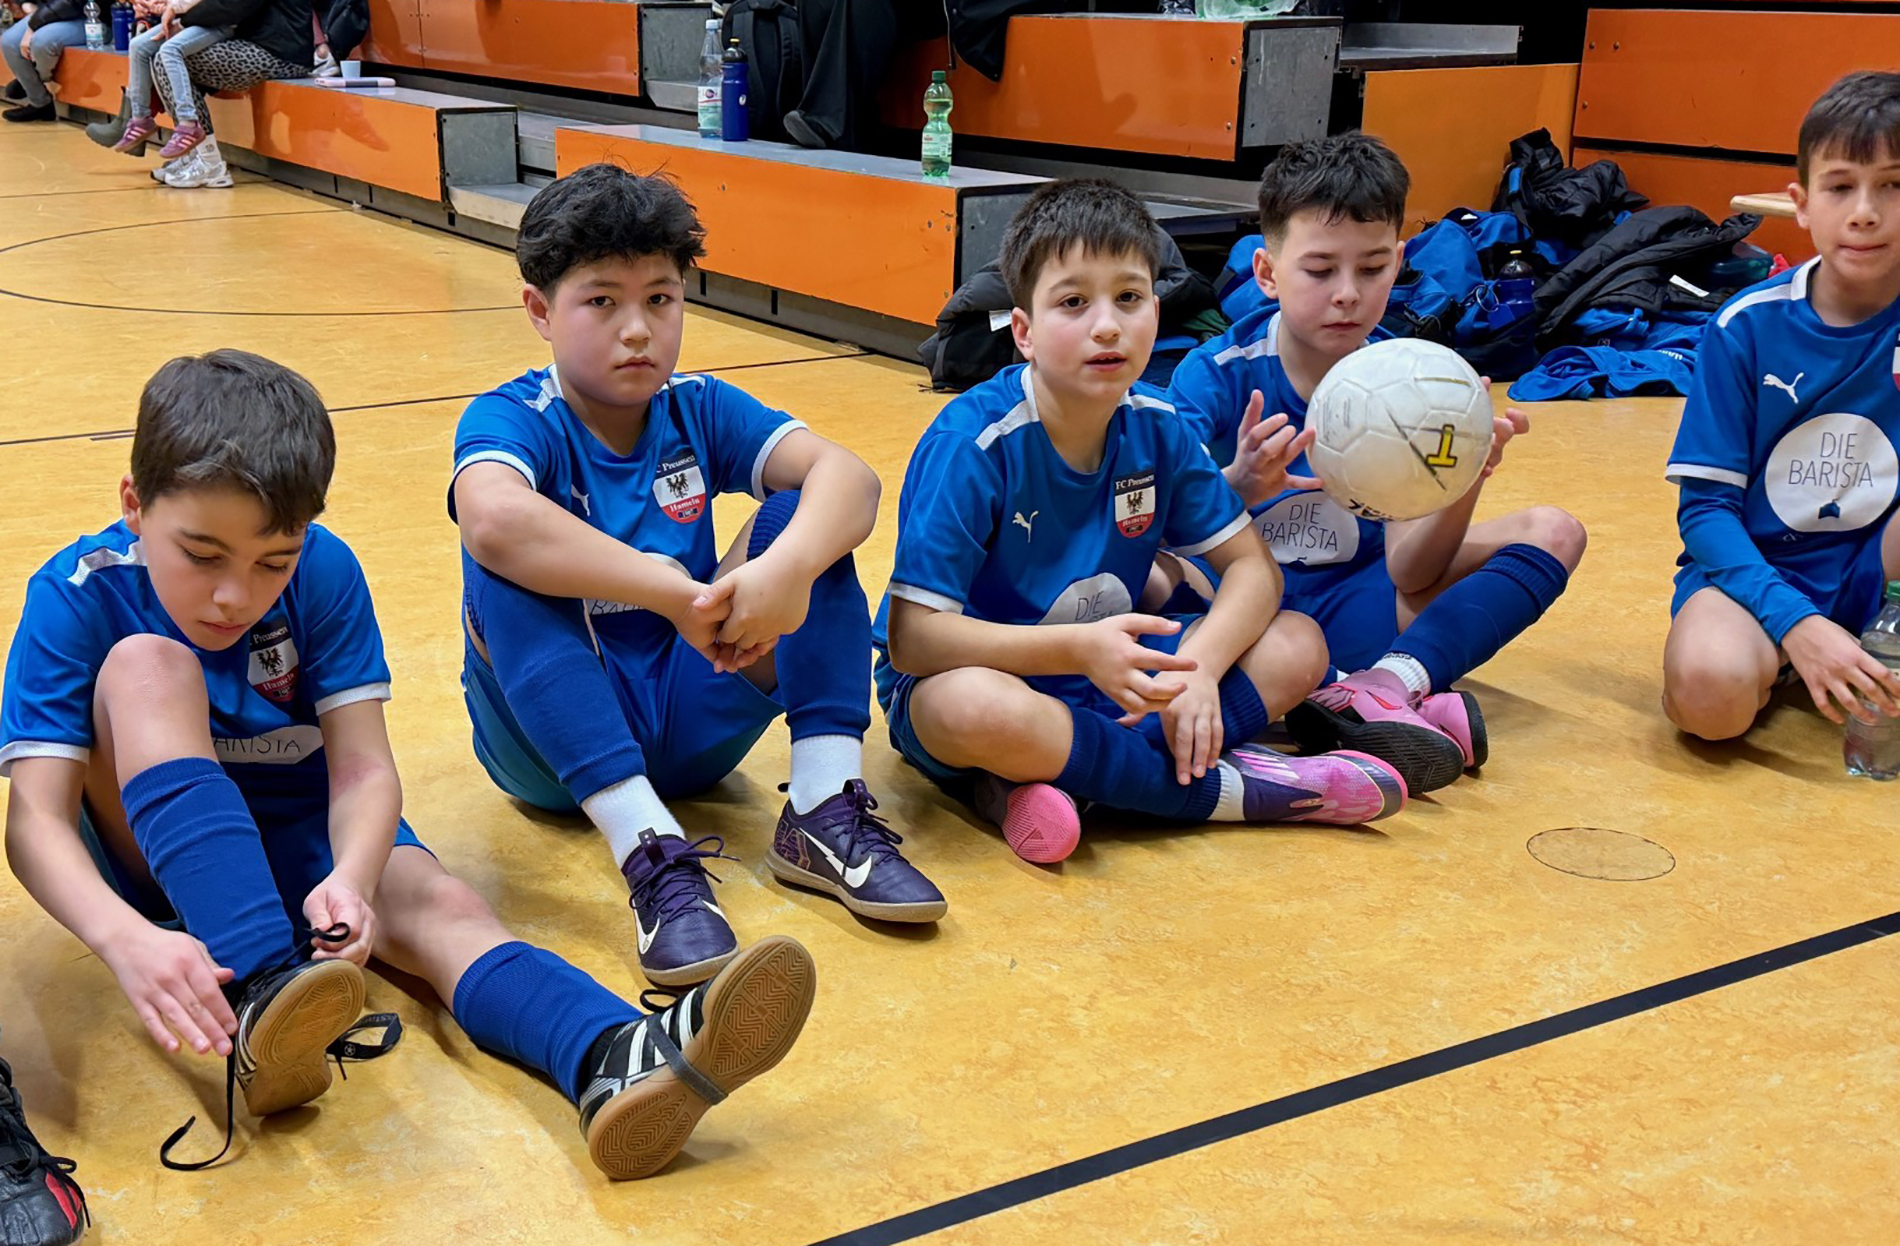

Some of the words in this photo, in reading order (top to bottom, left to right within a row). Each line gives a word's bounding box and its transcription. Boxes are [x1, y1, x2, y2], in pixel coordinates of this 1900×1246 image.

[1820, 432, 1858, 459] DIE
[1788, 459, 1873, 488] BARISTA
[1289, 503, 1322, 524] DIE
[1262, 522, 1338, 551] BARISTA
[1075, 590, 1104, 621] DIE
